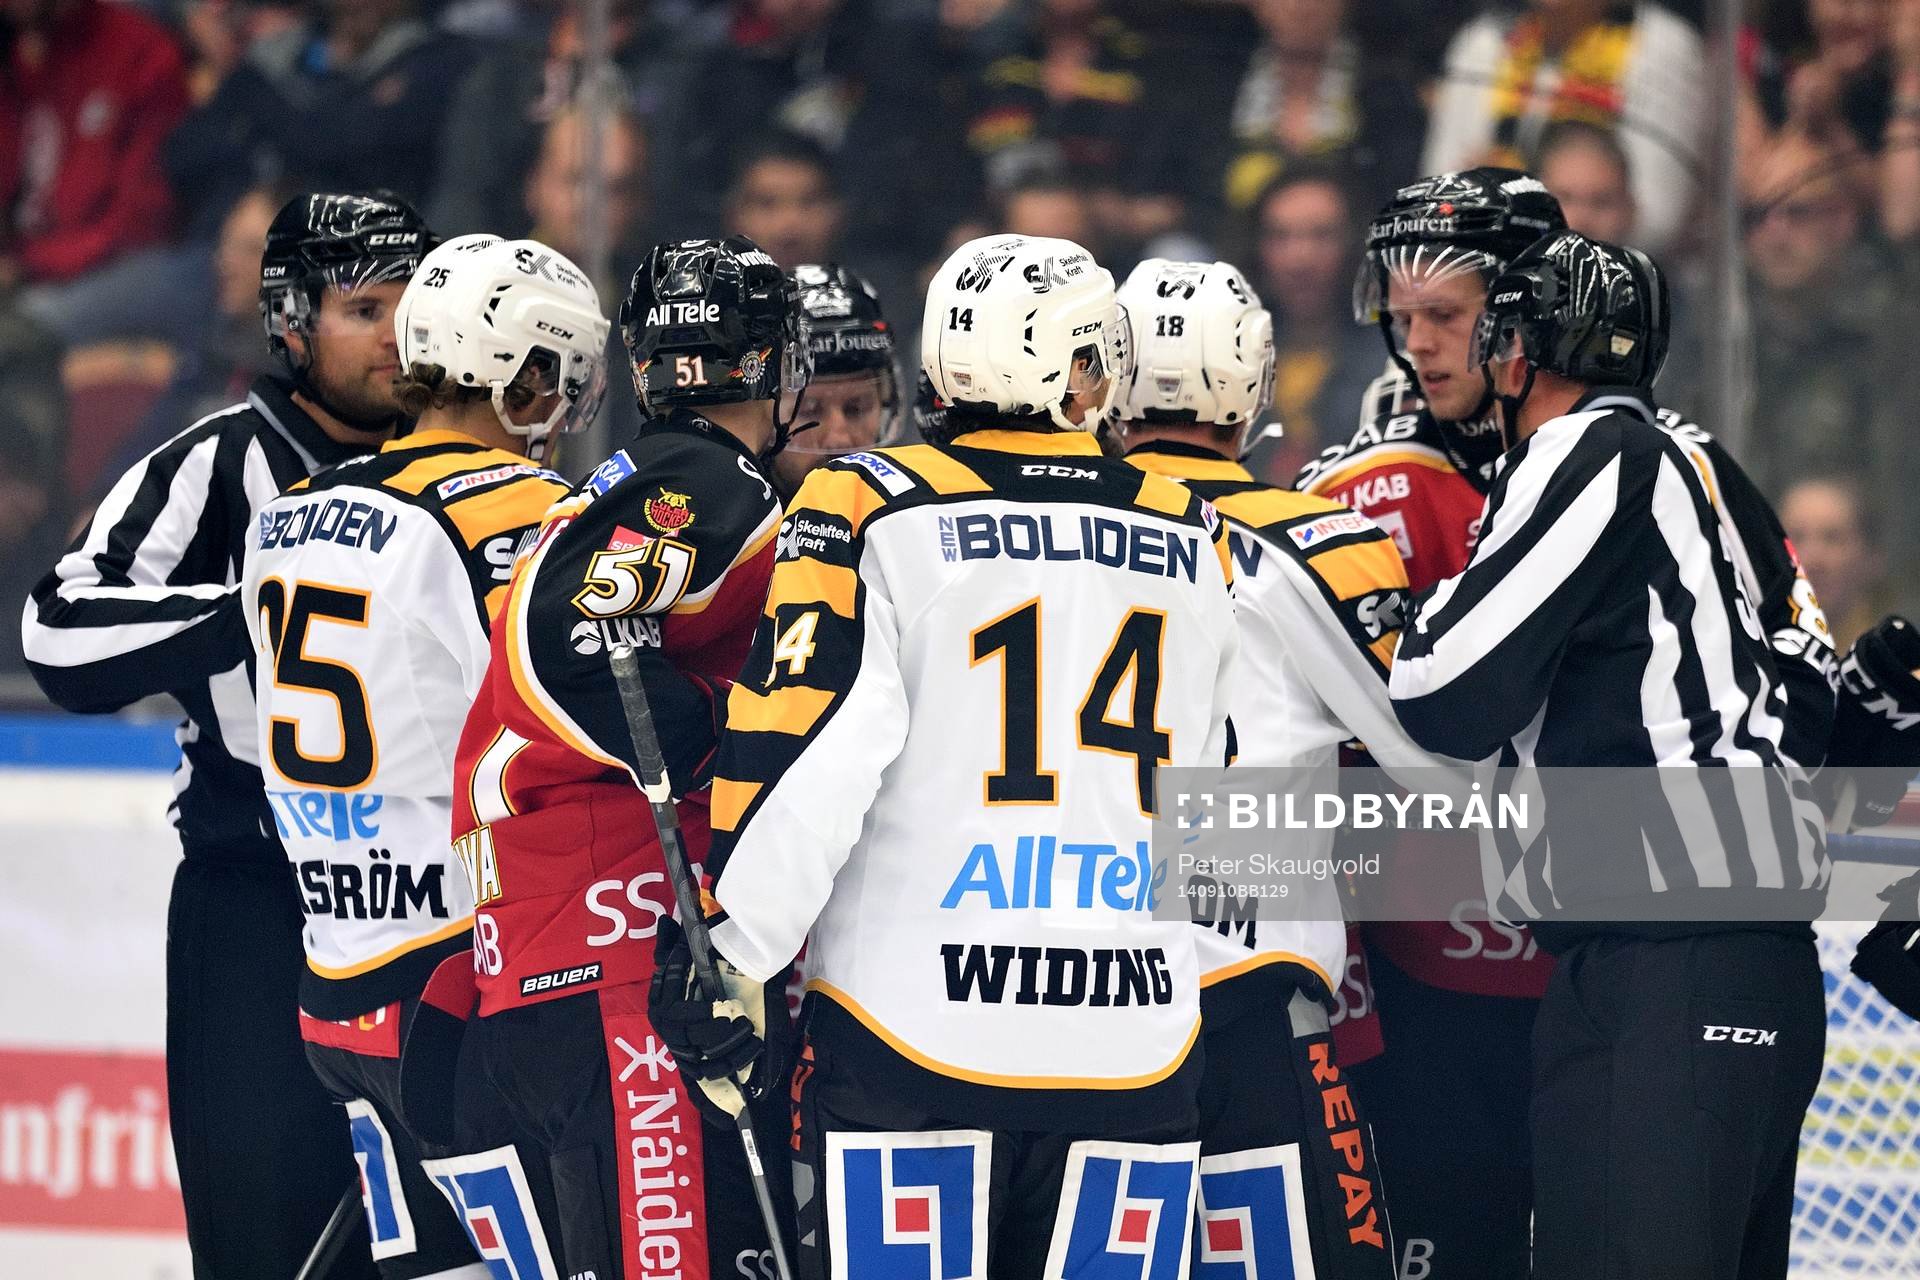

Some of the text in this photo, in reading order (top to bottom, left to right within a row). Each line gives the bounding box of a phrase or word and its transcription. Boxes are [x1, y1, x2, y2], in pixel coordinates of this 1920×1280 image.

[369, 232, 419, 247] CCM
[263, 265, 287, 278] CCM
[422, 267, 452, 289] 25
[1065, 266, 1085, 279] Kraft
[1493, 291, 1523, 305] CCM
[534, 319, 575, 342] CCM
[948, 307, 974, 332] 14
[1071, 320, 1103, 338] CCM
[1155, 315, 1185, 337] 18
[674, 355, 708, 387] 51
[1020, 464, 1099, 480] CCM
[954, 513, 1198, 585] BOLIDEN
[570, 537, 698, 619] 51
[770, 612, 821, 676] 4
[968, 595, 1174, 821] 14
[289, 848, 449, 920] SRÖM
[940, 943, 1174, 1007] WIDING
[1702, 1025, 1778, 1046] CCM
[1308, 1042, 1384, 1250] REPAY
